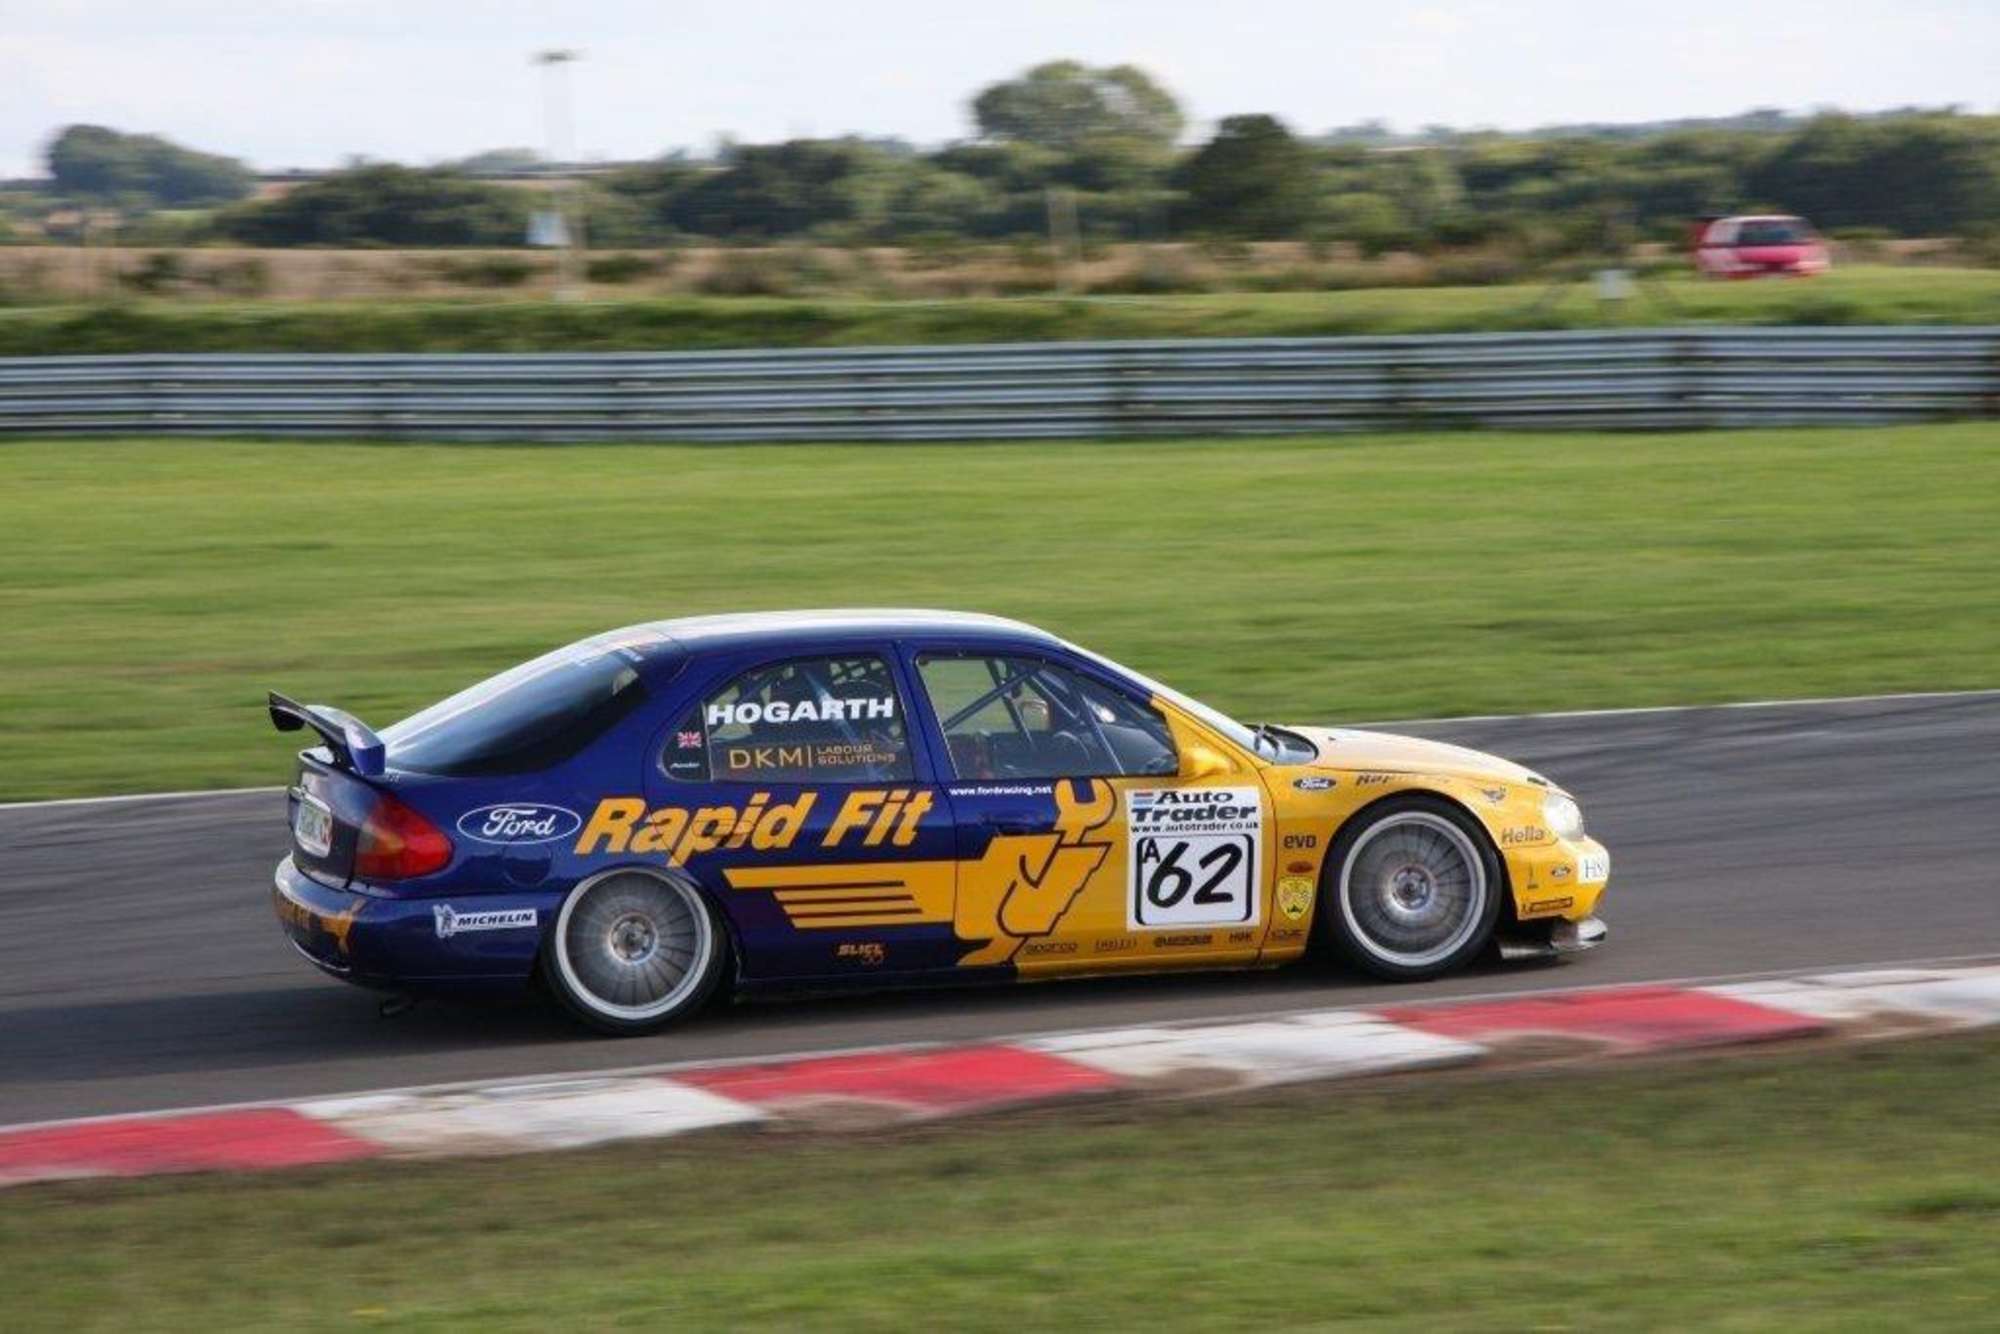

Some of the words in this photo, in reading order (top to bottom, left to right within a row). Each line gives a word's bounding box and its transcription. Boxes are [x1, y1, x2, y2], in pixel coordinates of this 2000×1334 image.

[707, 698, 894, 725] HOGARTH
[729, 747, 802, 769] DKM
[1153, 789, 1234, 804] Auto
[482, 807, 557, 836] Ford
[1132, 805, 1257, 822] Trader
[573, 792, 817, 868] Rapid
[821, 789, 933, 847] Fit
[1131, 822, 1259, 833] www.autotrader.co.uk
[1501, 826, 1545, 843] Hella
[1142, 838, 1161, 864] A
[1147, 841, 1243, 909] 62
[457, 911, 532, 927] MICHELIN
